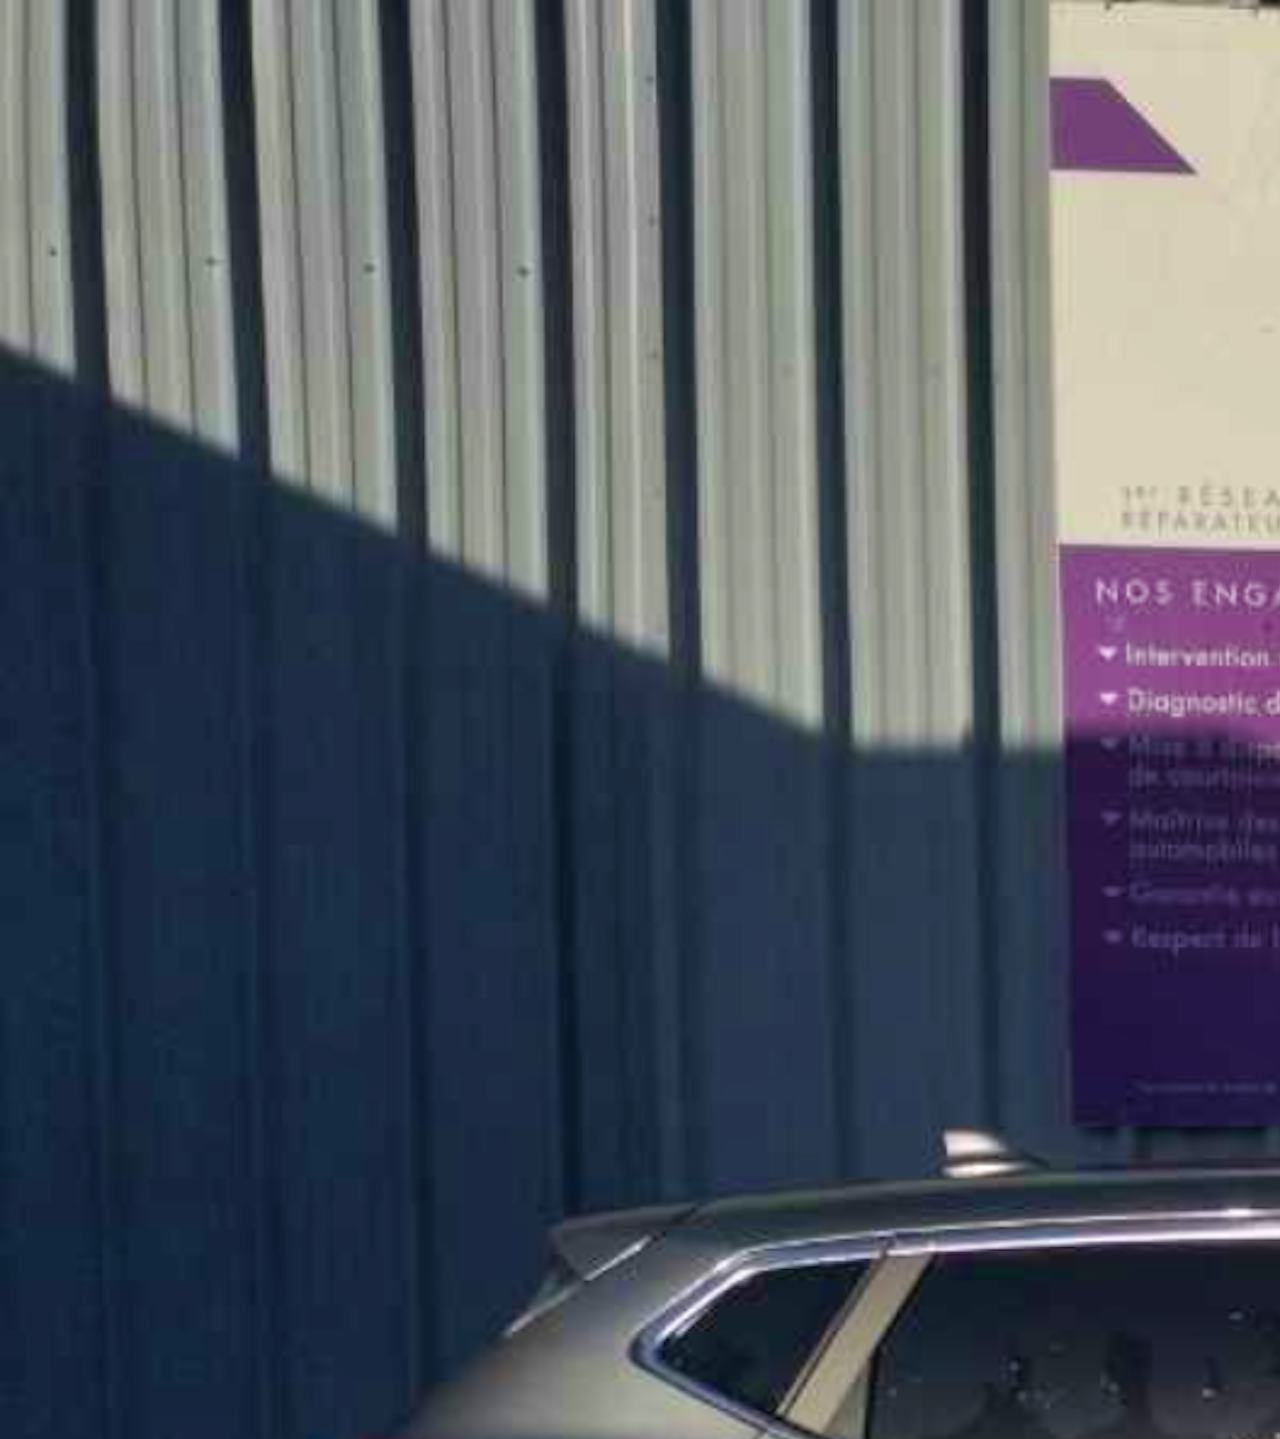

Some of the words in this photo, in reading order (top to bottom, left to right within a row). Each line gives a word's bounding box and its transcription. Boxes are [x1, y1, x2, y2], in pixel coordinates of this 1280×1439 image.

[1096, 578, 1173, 606] NOS
[1126, 643, 1269, 667] Intervention
[1128, 688, 1259, 717] Diagnostic
